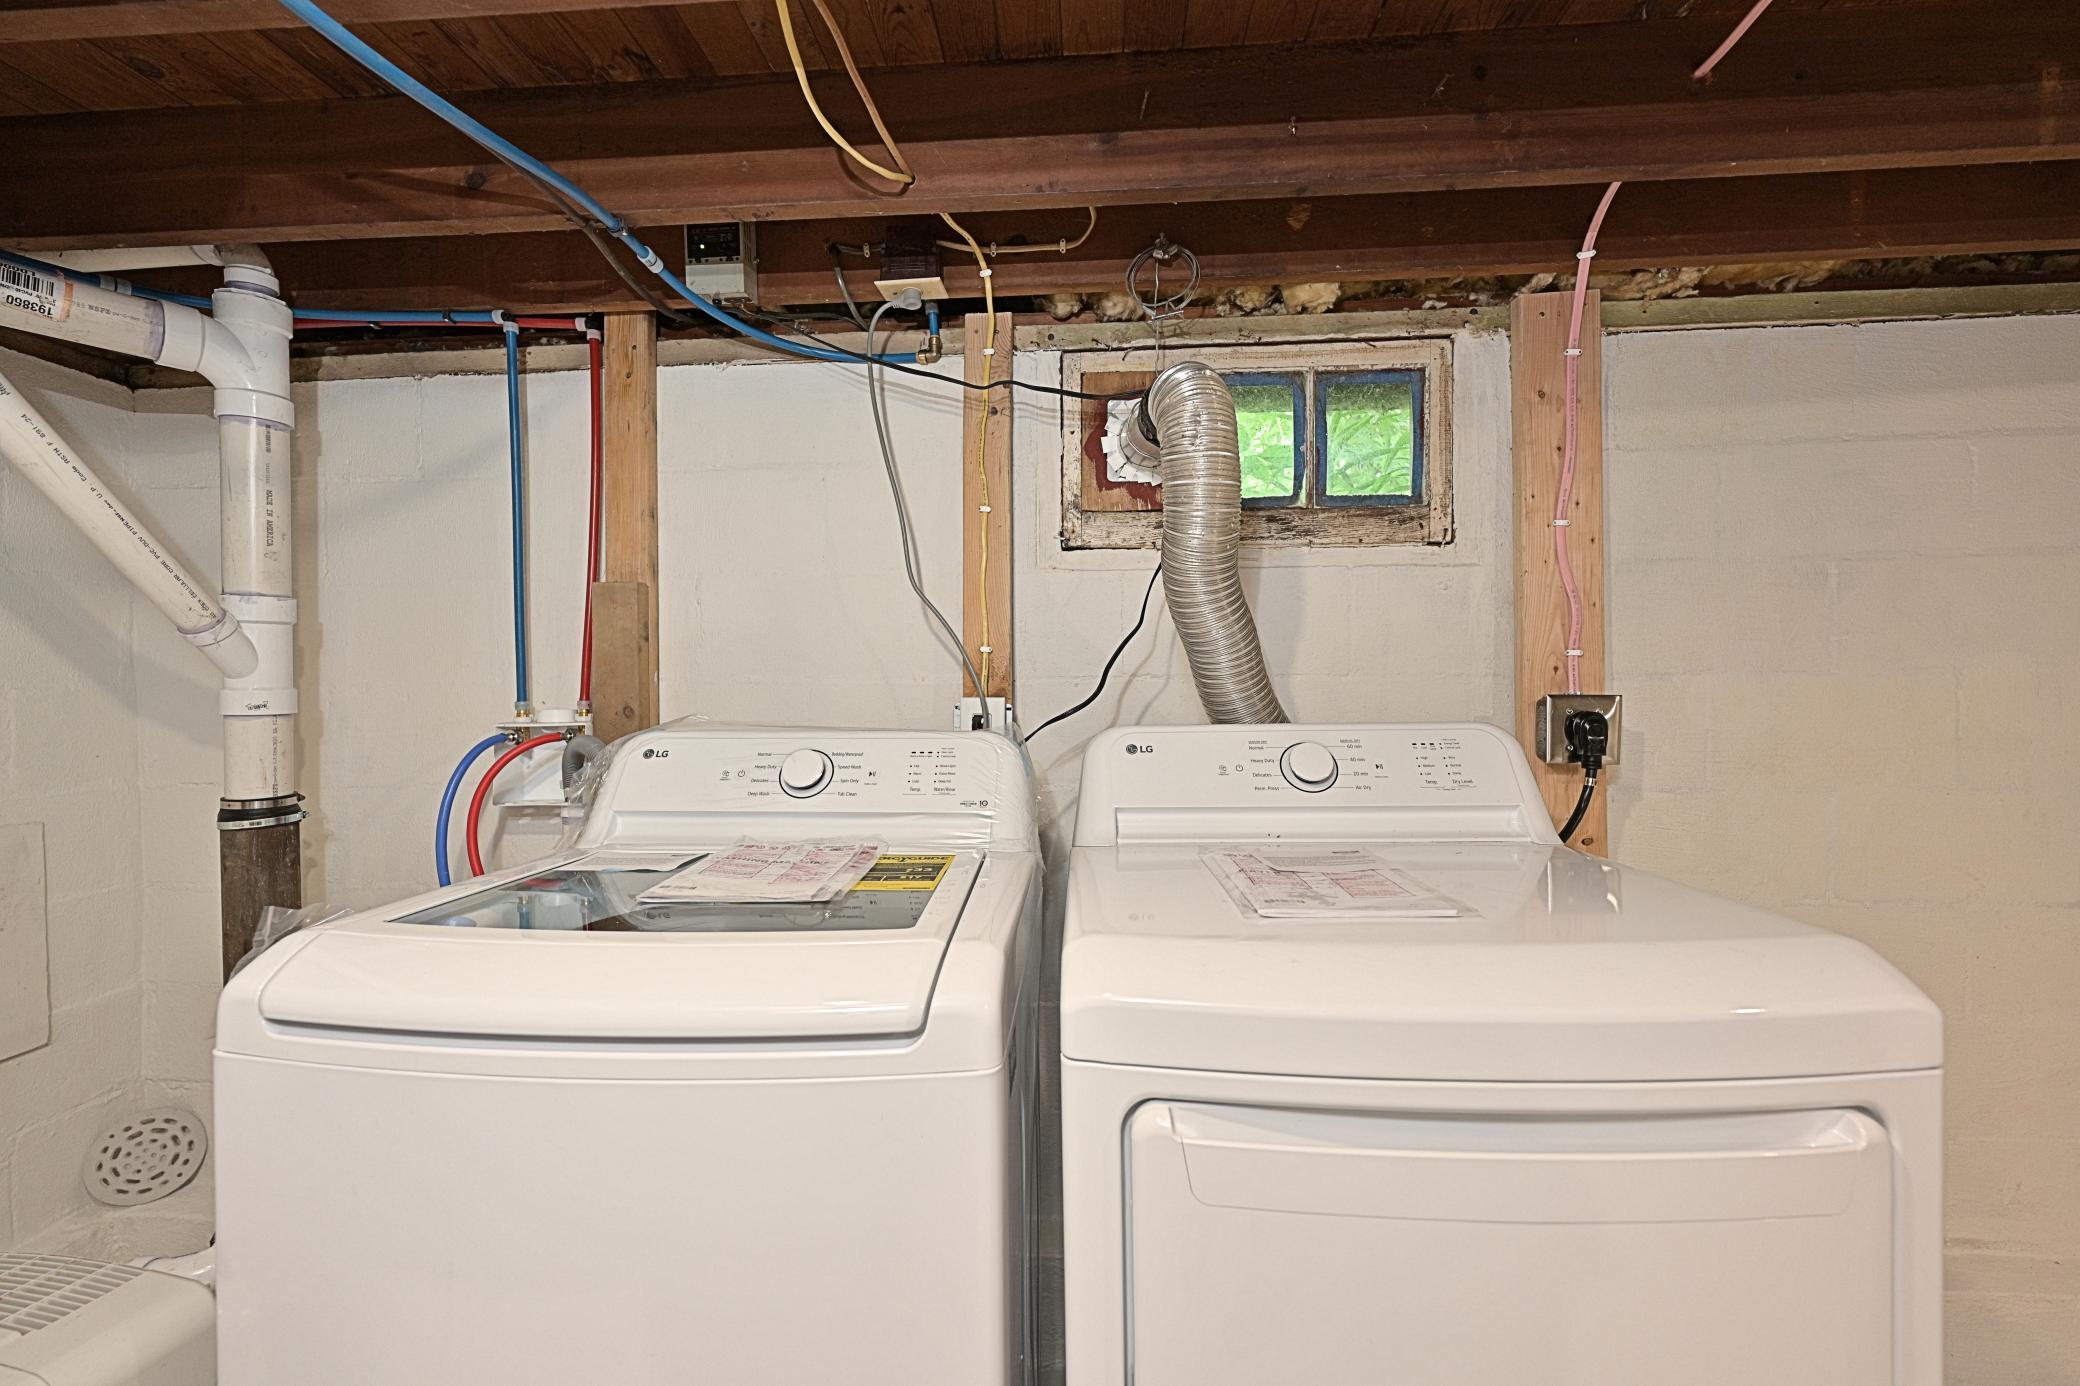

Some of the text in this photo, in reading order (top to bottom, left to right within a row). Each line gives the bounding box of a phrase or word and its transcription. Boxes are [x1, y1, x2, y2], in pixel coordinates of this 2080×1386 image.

[6, 294, 53, 316] 193860
[72, 465, 87, 482] Code
[266, 508, 273, 518] IN
[123, 521, 138, 536] PIPE
[266, 520, 274, 547] AMERICA
[161, 560, 174, 574] CORE
[174, 573, 198, 599] CELLULAR
[656, 750, 669, 758] LG
[1139, 745, 1153, 753] LG
